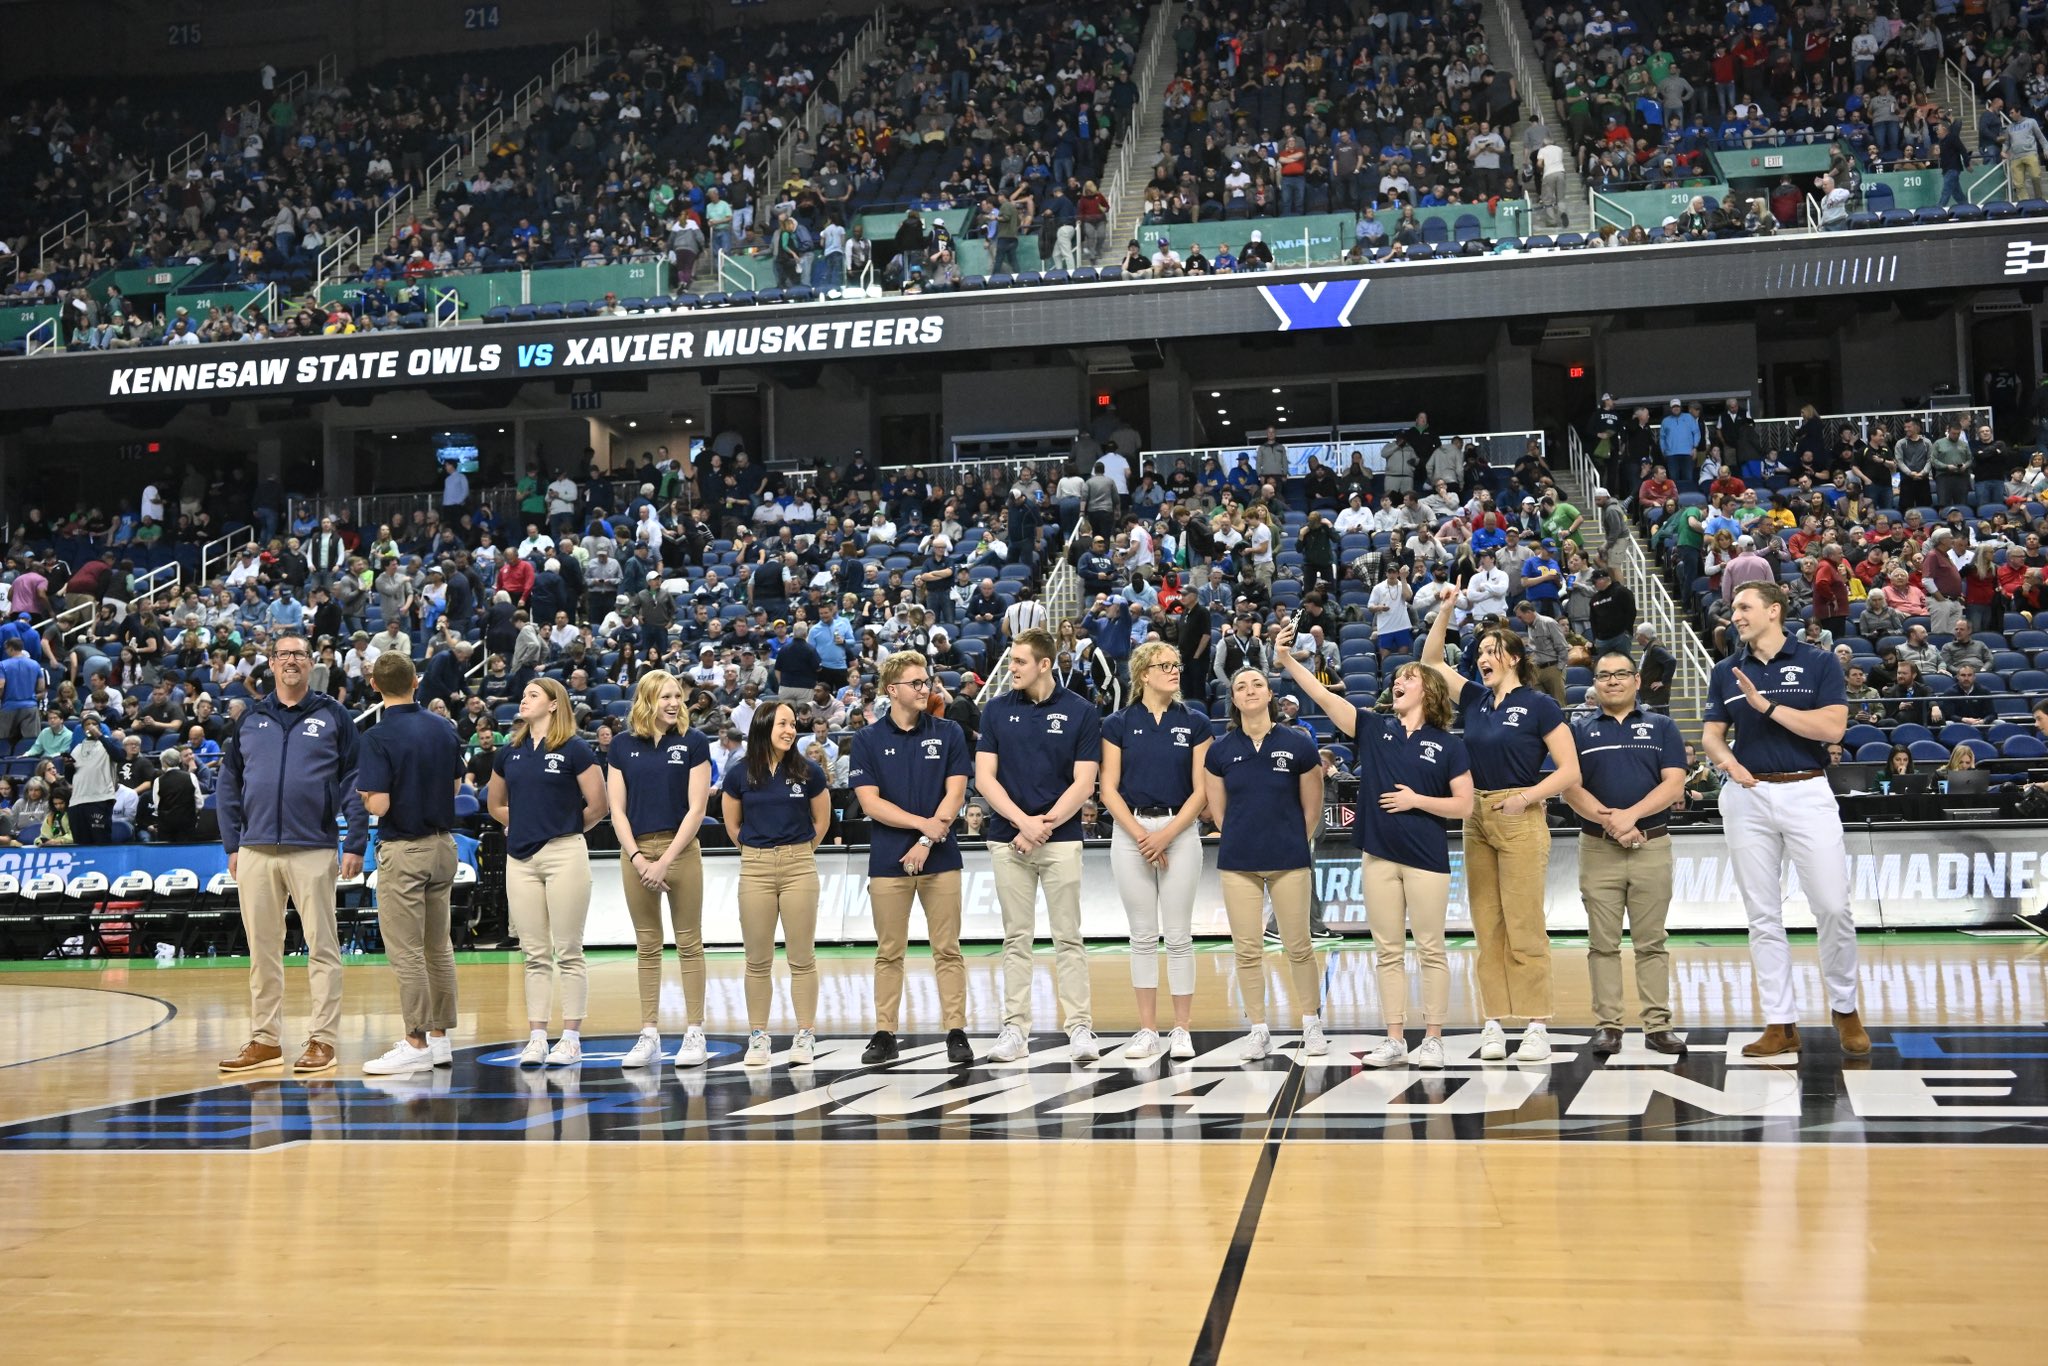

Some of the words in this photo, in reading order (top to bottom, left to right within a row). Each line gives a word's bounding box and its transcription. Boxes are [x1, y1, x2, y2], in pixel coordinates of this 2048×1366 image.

[464, 6, 500, 29] 214
[168, 23, 201, 46] 215
[1766, 156, 1782, 167] EXIT
[1904, 177, 1922, 187] 210
[1671, 194, 1688, 205] 210
[1144, 232, 1159, 242] 211
[629, 269, 645, 278] 213
[196, 299, 211, 309] 214
[21, 312, 35, 321] 214
[110, 358, 289, 395] KENNESAW
[296, 350, 399, 384] STATE
[407, 344, 501, 376] OWLS
[517, 343, 554, 368] VS
[563, 331, 695, 367] XAVIER
[704, 316, 944, 358] MUSKETEERS
[574, 394, 600, 410] 111
[1098, 395, 1110, 405] EXIT
[119, 444, 143, 460] 112
[1855, 850, 2048, 900] MADNE
